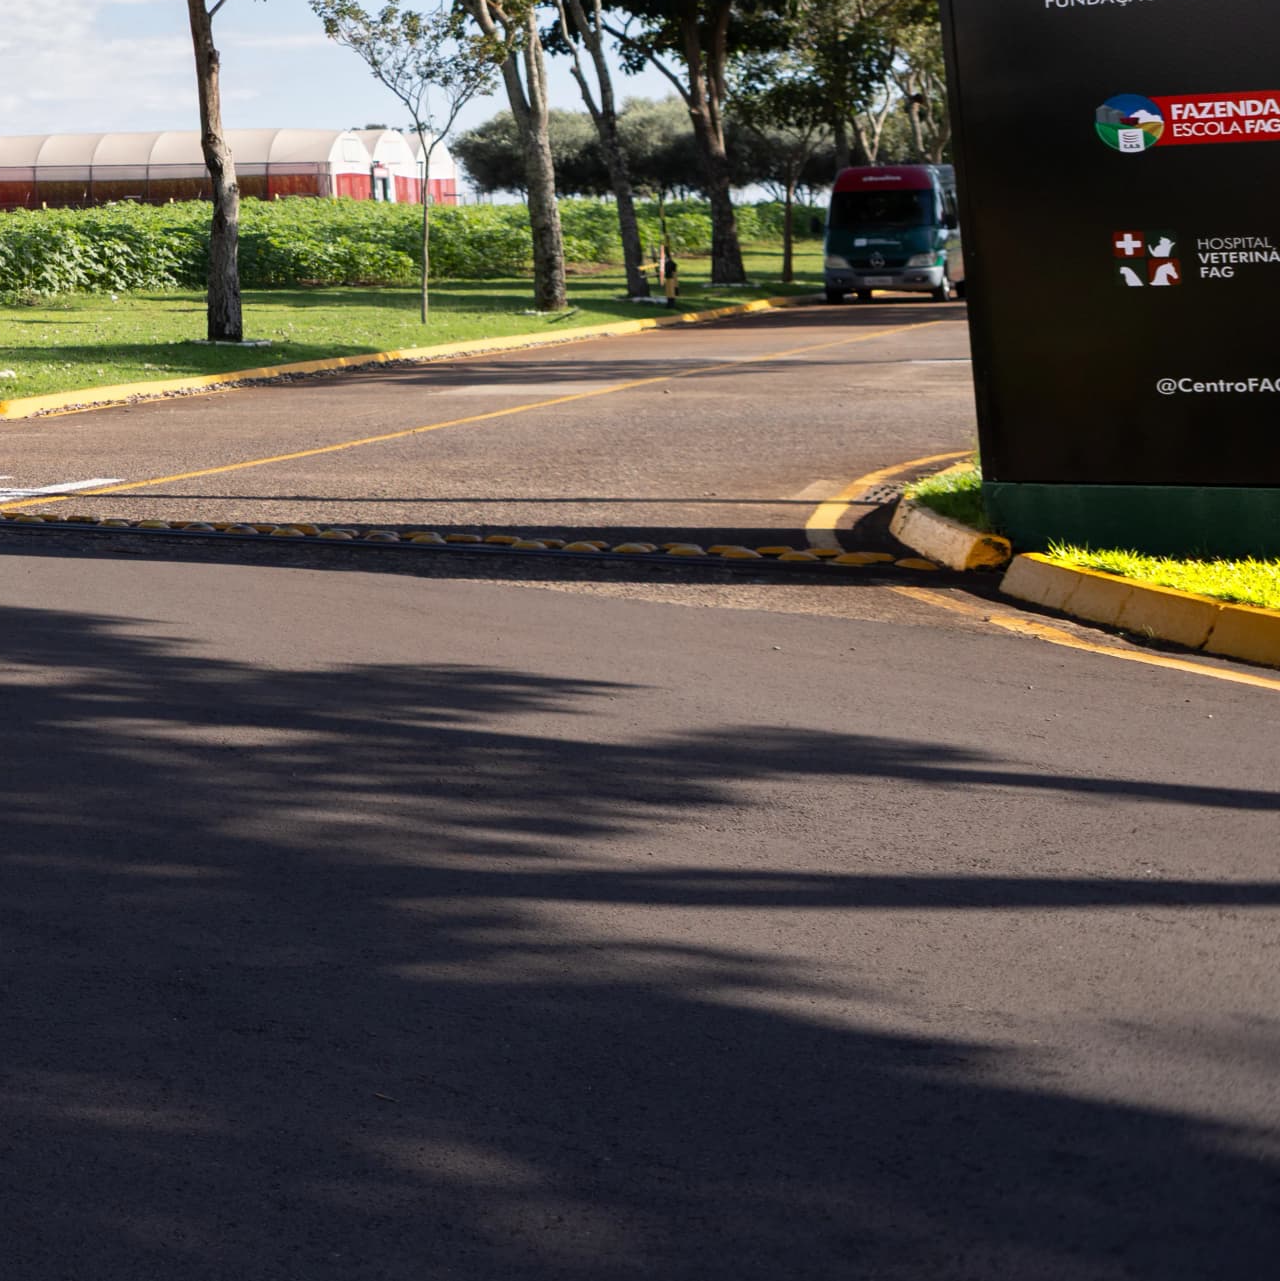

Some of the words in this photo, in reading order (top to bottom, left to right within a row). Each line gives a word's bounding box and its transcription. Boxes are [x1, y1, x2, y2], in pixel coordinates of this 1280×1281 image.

[1170, 98, 1280, 121] FAZENDA
[1172, 121, 1243, 137] ESCOLA
[1244, 118, 1280, 134] FAG
[1197, 236, 1273, 250] HOSPITAL
[1198, 247, 1280, 264] VETERINÁ
[1200, 266, 1235, 279] FAG
